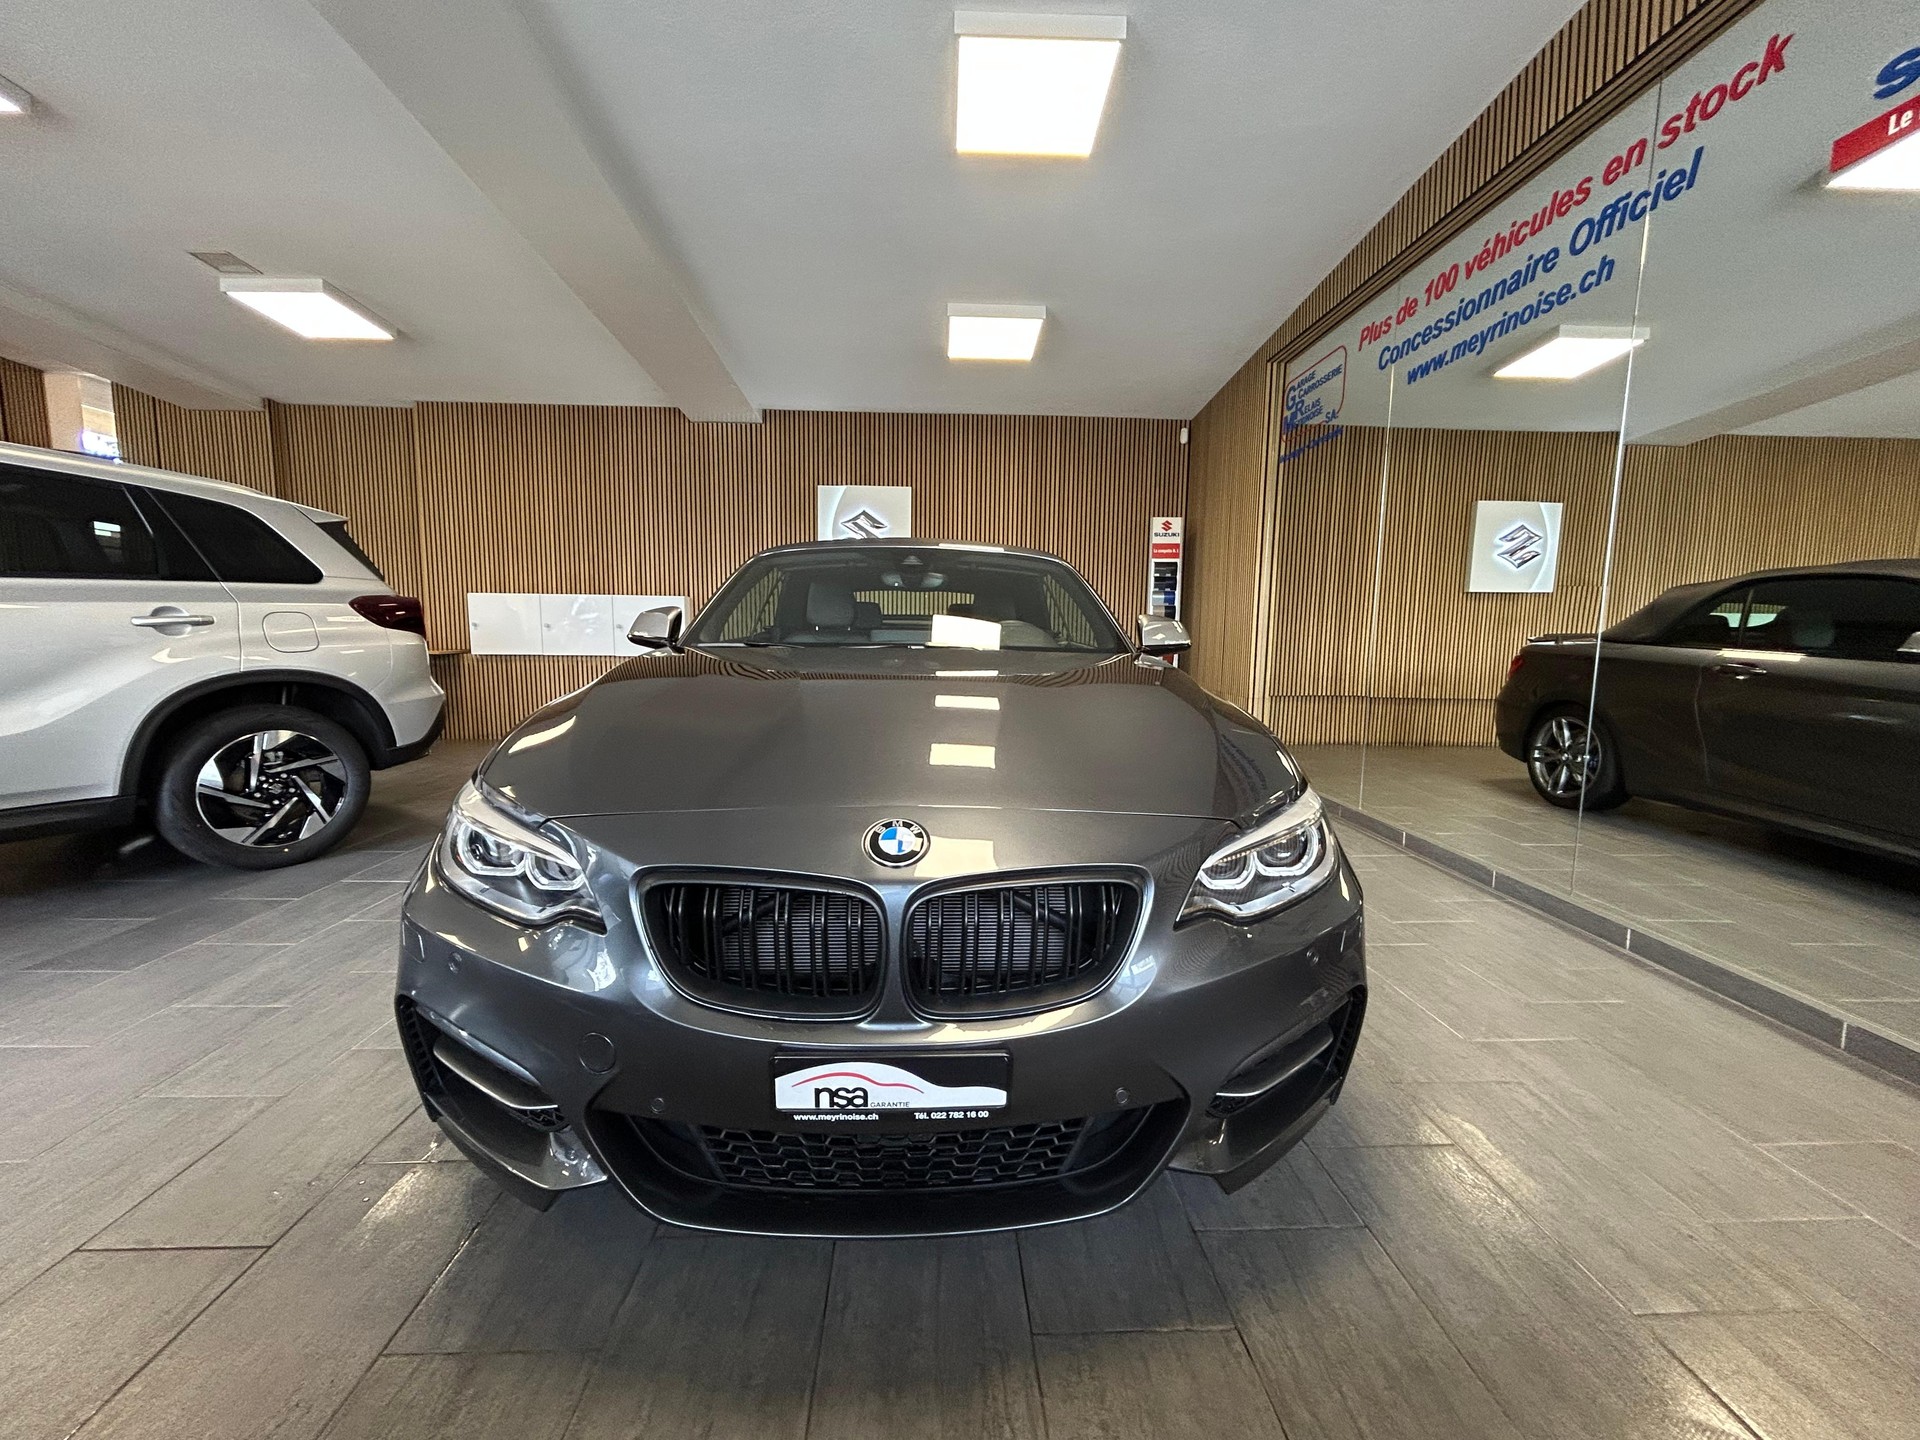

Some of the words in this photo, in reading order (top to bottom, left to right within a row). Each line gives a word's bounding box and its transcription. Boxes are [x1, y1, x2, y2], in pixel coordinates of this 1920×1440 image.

[1888, 109, 1914, 136] Le
[1358, 315, 1393, 352] Plus
[1395, 296, 1419, 326] de
[1424, 263, 1460, 307] 100
[1464, 176, 1594, 280] véhicules
[1602, 137, 1648, 186] en
[1657, 33, 1795, 149] stock
[1378, 245, 1560, 371] Concessionnaire
[1568, 145, 1705, 256] Officiel
[1406, 254, 1616, 385] www.meyrinoise.ch
[1298, 364, 1343, 399] CARROSSERIE
[874, 820, 922, 835] BMW
[814, 1087, 868, 1109] nsa
[793, 1113, 879, 1121] www.meyrinoise.ch
[948, 1111, 964, 1119] 782
[978, 1110, 989, 1118] 00
